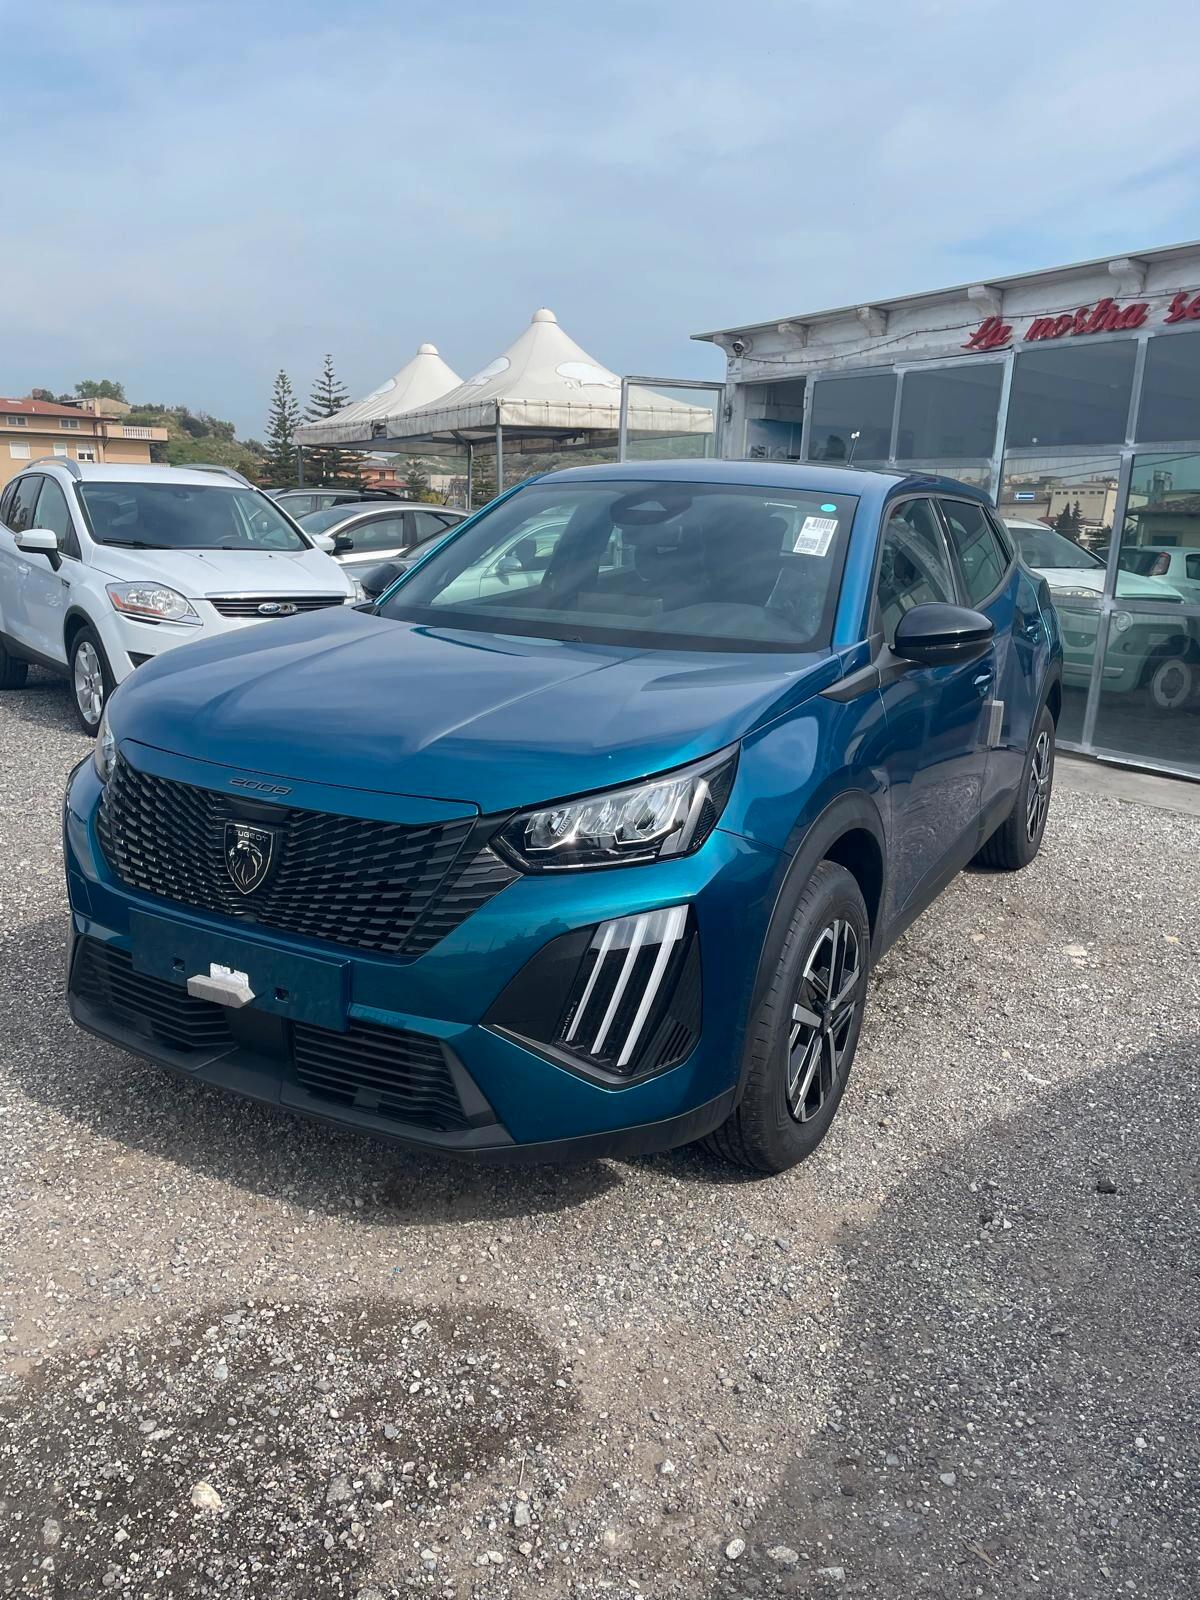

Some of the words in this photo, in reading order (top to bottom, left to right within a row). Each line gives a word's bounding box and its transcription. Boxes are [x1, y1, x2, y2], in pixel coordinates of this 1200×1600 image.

[960, 316, 1013, 350] La
[1023, 297, 1149, 341] nostra
[229, 778, 291, 795] 2008
[228, 828, 268, 842] UGEOT
